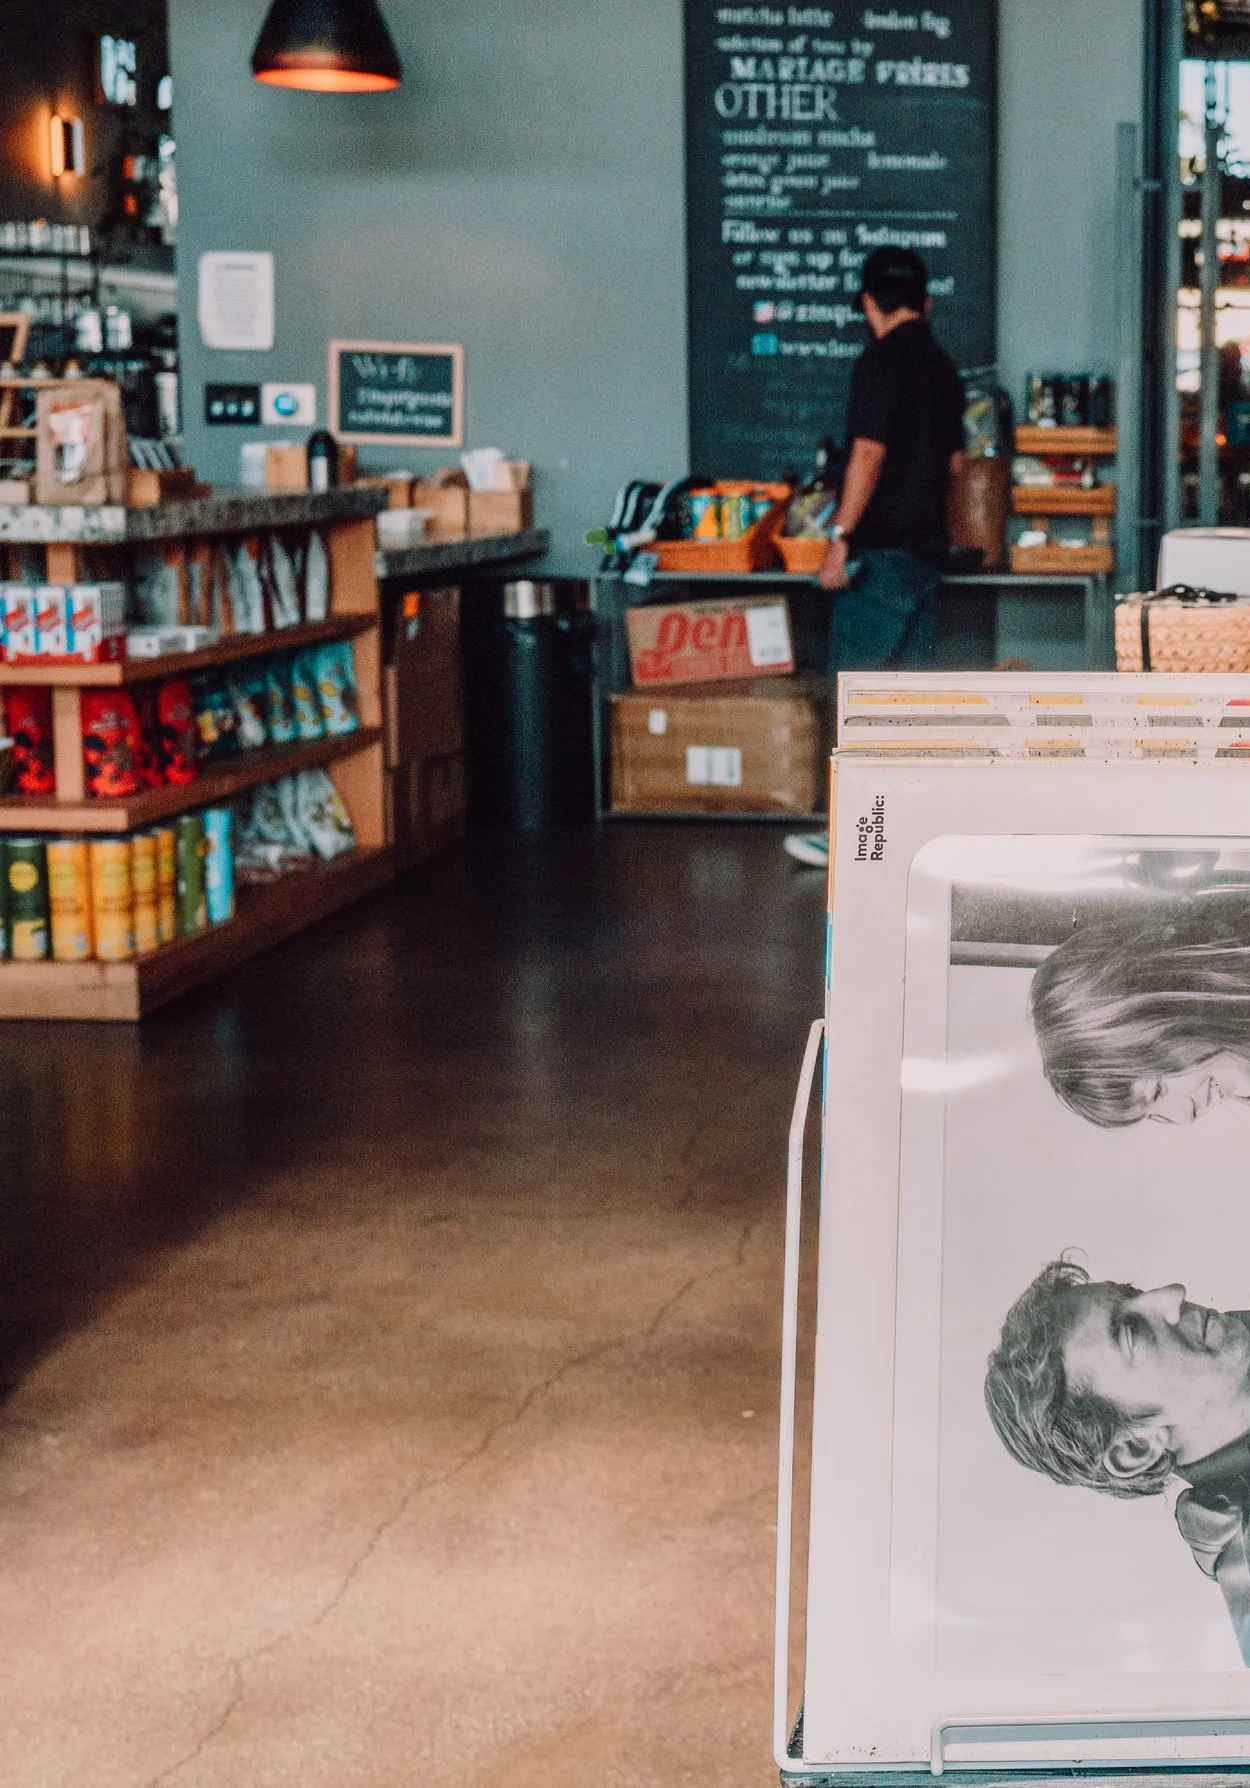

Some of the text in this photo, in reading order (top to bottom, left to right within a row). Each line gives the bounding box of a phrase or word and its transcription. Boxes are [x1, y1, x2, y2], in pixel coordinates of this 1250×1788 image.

[714, 81, 840, 121] OTHER
[722, 219, 780, 243] Follow
[788, 228, 813, 244] us
[822, 228, 847, 245] on
[806, 251, 833, 270] up
[854, 816, 874, 861] Image
[870, 795, 888, 861] Republic:
